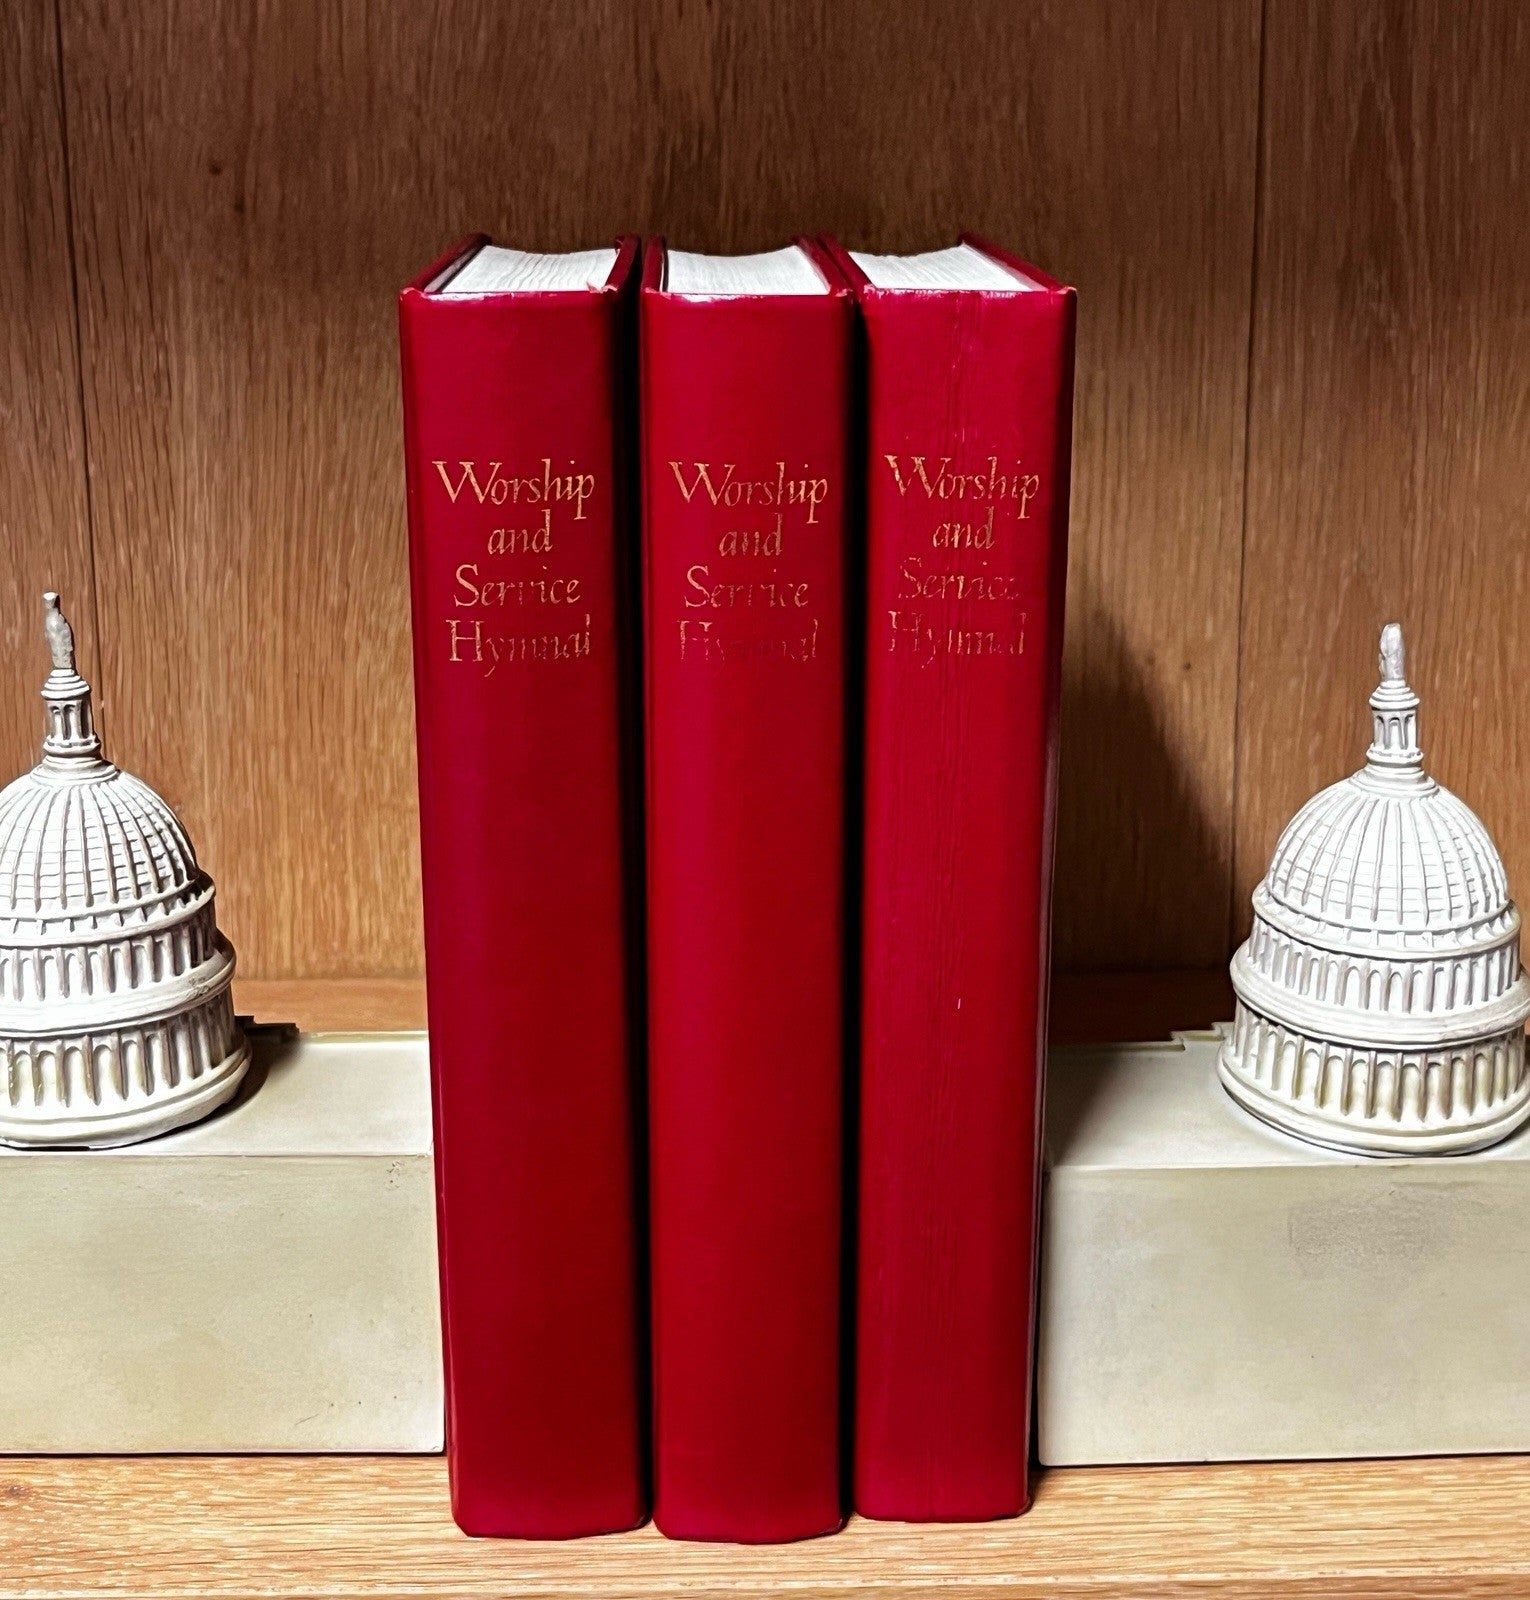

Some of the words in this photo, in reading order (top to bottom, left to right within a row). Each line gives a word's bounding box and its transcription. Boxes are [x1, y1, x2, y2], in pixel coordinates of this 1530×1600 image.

[432, 458, 595, 520] Worship
[667, 461, 828, 524] Worship
[884, 454, 1040, 519] Worship
[487, 508, 553, 555] and
[718, 512, 783, 556] and
[932, 505, 995, 549] and
[887, 610, 1027, 669] Hymnl
